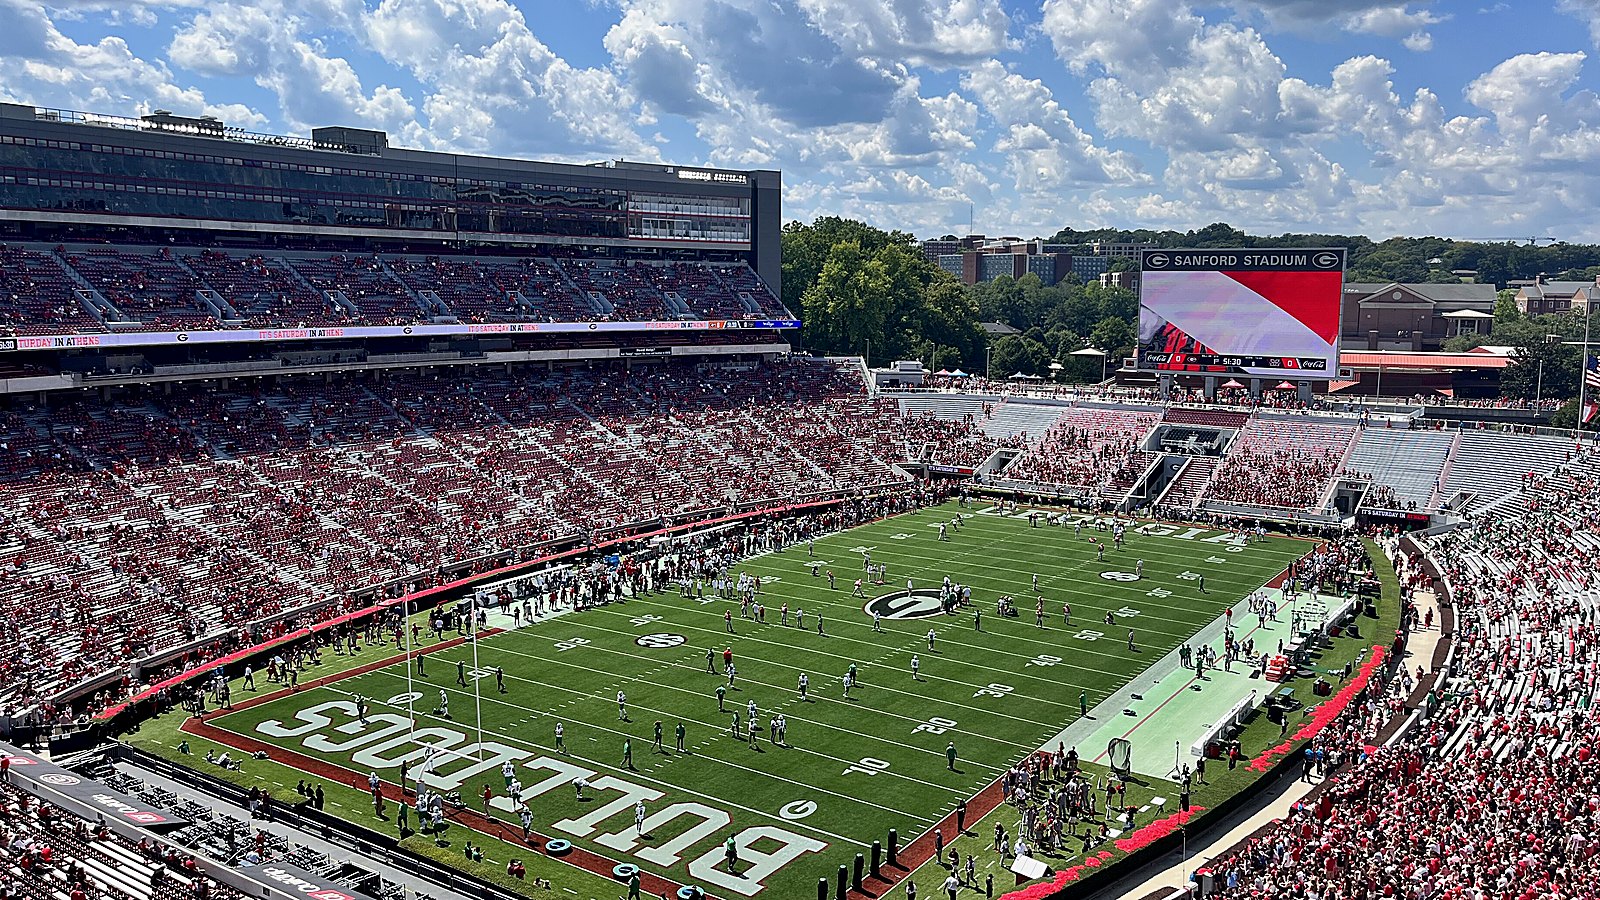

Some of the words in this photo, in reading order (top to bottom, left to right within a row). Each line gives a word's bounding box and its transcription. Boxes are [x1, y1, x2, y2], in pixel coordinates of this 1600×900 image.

[1174, 255, 1237, 266] SANFORD
[1243, 255, 1307, 266] STADIUM
[260, 331, 272, 339] IT'S
[274, 330, 307, 338] SATURDAY
[318, 329, 343, 337] ATHENS
[55, 338, 64, 347] IN
[66, 337, 99, 346] ATHENS
[1223, 358, 1241, 366] 51:30
[1029, 654, 1062, 667] 40
[976, 683, 1014, 698] 30
[918, 717, 957, 734] 20
[849, 757, 890, 776] 10
[256, 700, 828, 895] BULLDOGS
[779, 800, 818, 820] G
